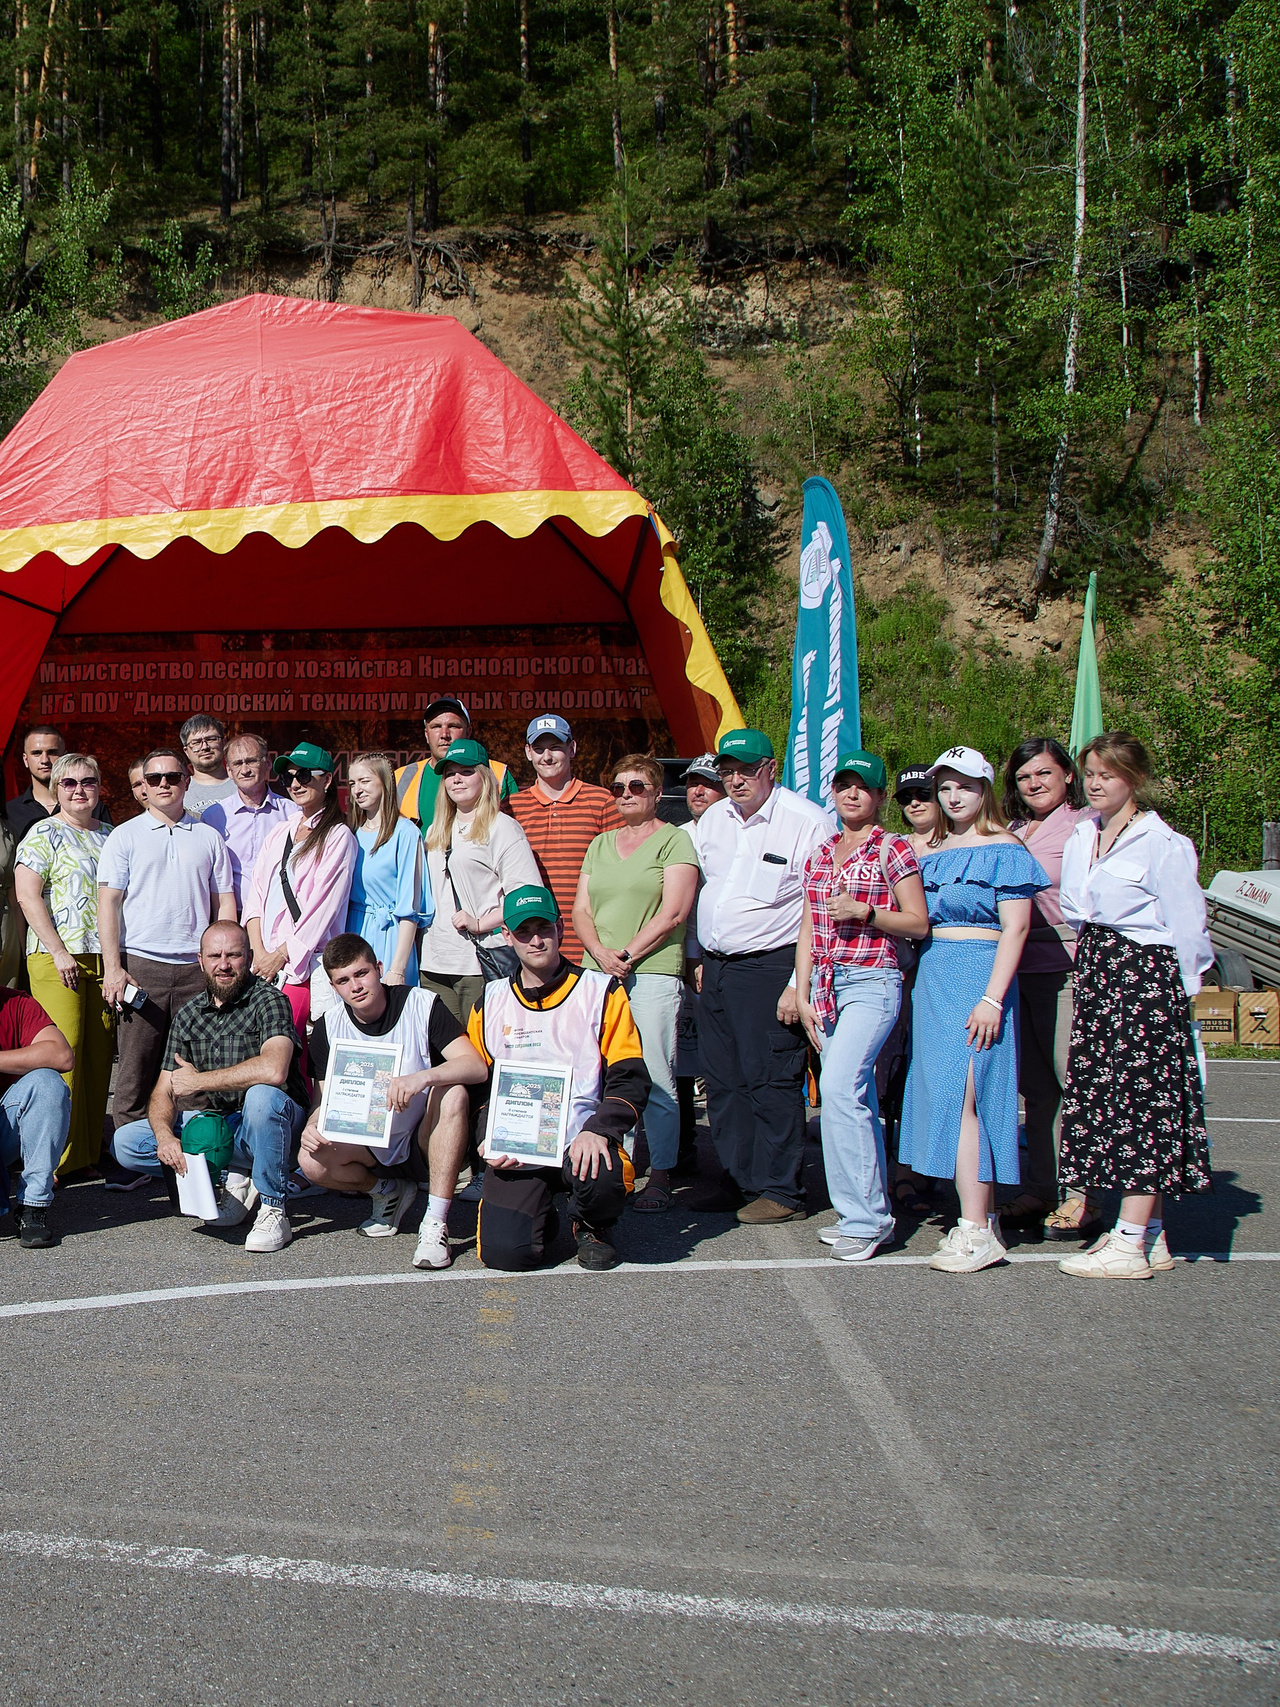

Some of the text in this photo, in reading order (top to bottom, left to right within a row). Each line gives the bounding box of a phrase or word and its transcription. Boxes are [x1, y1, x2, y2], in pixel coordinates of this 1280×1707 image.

[39, 660, 195, 683] Министерство
[199, 659, 289, 680] лесного
[294, 655, 412, 680] хозяйства
[419, 654, 595, 680] Красноярского
[81, 692, 119, 714] ПОУ
[124, 689, 294, 716] "Дивногорский
[300, 691, 408, 712] техникум
[414, 691, 504, 710] леных
[509, 686, 650, 710] технологий"
[900, 771, 926, 783] BABE
[339, 1078, 366, 1086] ДИПЛОМ
[504, 1099, 534, 1107] ДИПЛОМ
